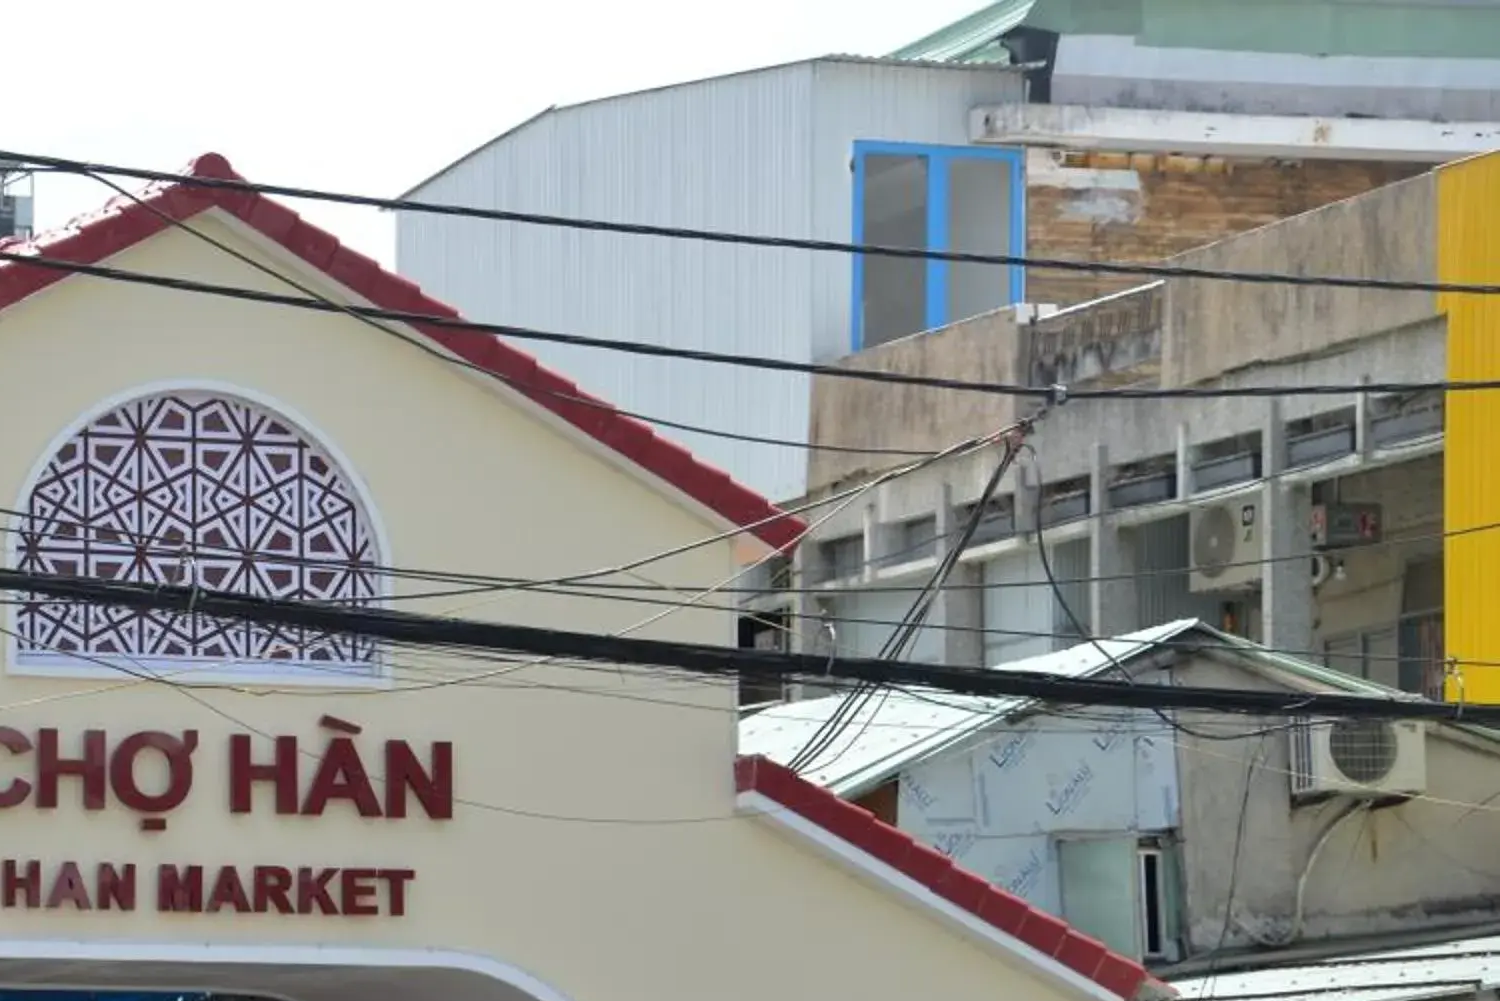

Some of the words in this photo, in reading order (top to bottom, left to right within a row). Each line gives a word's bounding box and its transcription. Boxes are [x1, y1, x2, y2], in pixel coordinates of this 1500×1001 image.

[228, 713, 453, 820] HÀN
[2, 859, 136, 912] HAN
[157, 863, 416, 917] MARKET
